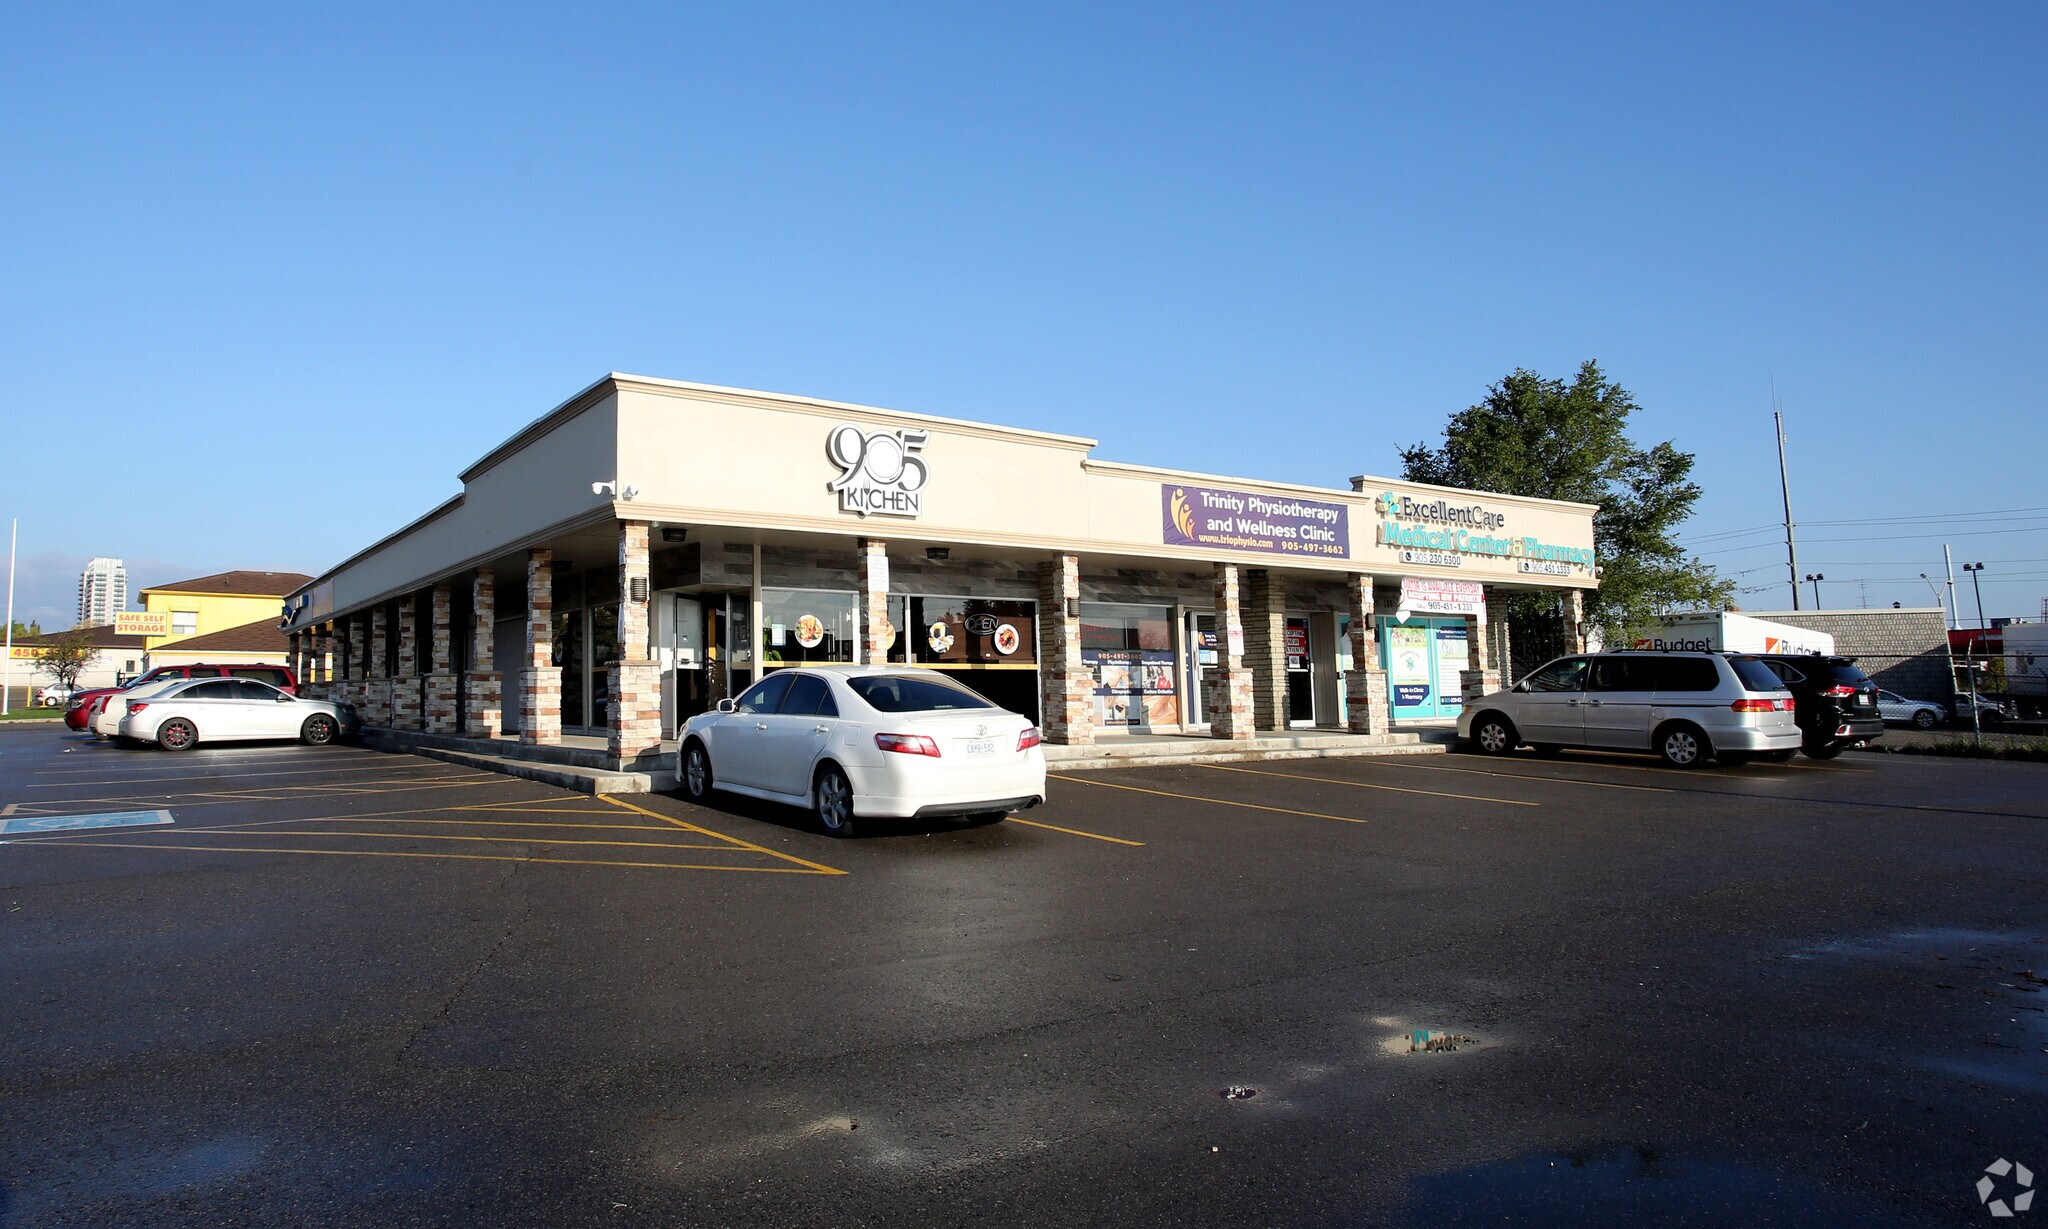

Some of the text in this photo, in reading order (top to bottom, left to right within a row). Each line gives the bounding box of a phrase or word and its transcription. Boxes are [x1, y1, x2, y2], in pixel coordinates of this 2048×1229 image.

[833, 426, 929, 492] 905
[846, 486, 919, 512] KITCHEN
[1200, 492, 1339, 524] Trinity Physiotherapy
[1402, 497, 1505, 528] ExcellentCare
[1206, 517, 1336, 542] and Wellness Clinic
[1198, 534, 1344, 555] www.triophysio.com 905-497-3662
[1384, 521, 1453, 550] Medical
[1456, 529, 1512, 555] Center
[1525, 537, 1596, 568] Pharmacy
[1414, 552, 1461, 566] 905 230 6300
[1531, 562, 1571, 575] 905 451 1333
[1427, 601, 1473, 611] 905-451-1333
[118, 614, 140, 622] SAFE
[966, 617, 1000, 630] OPEN
[117, 624, 165, 632] STORAGE
[1654, 637, 1711, 651] Budget
